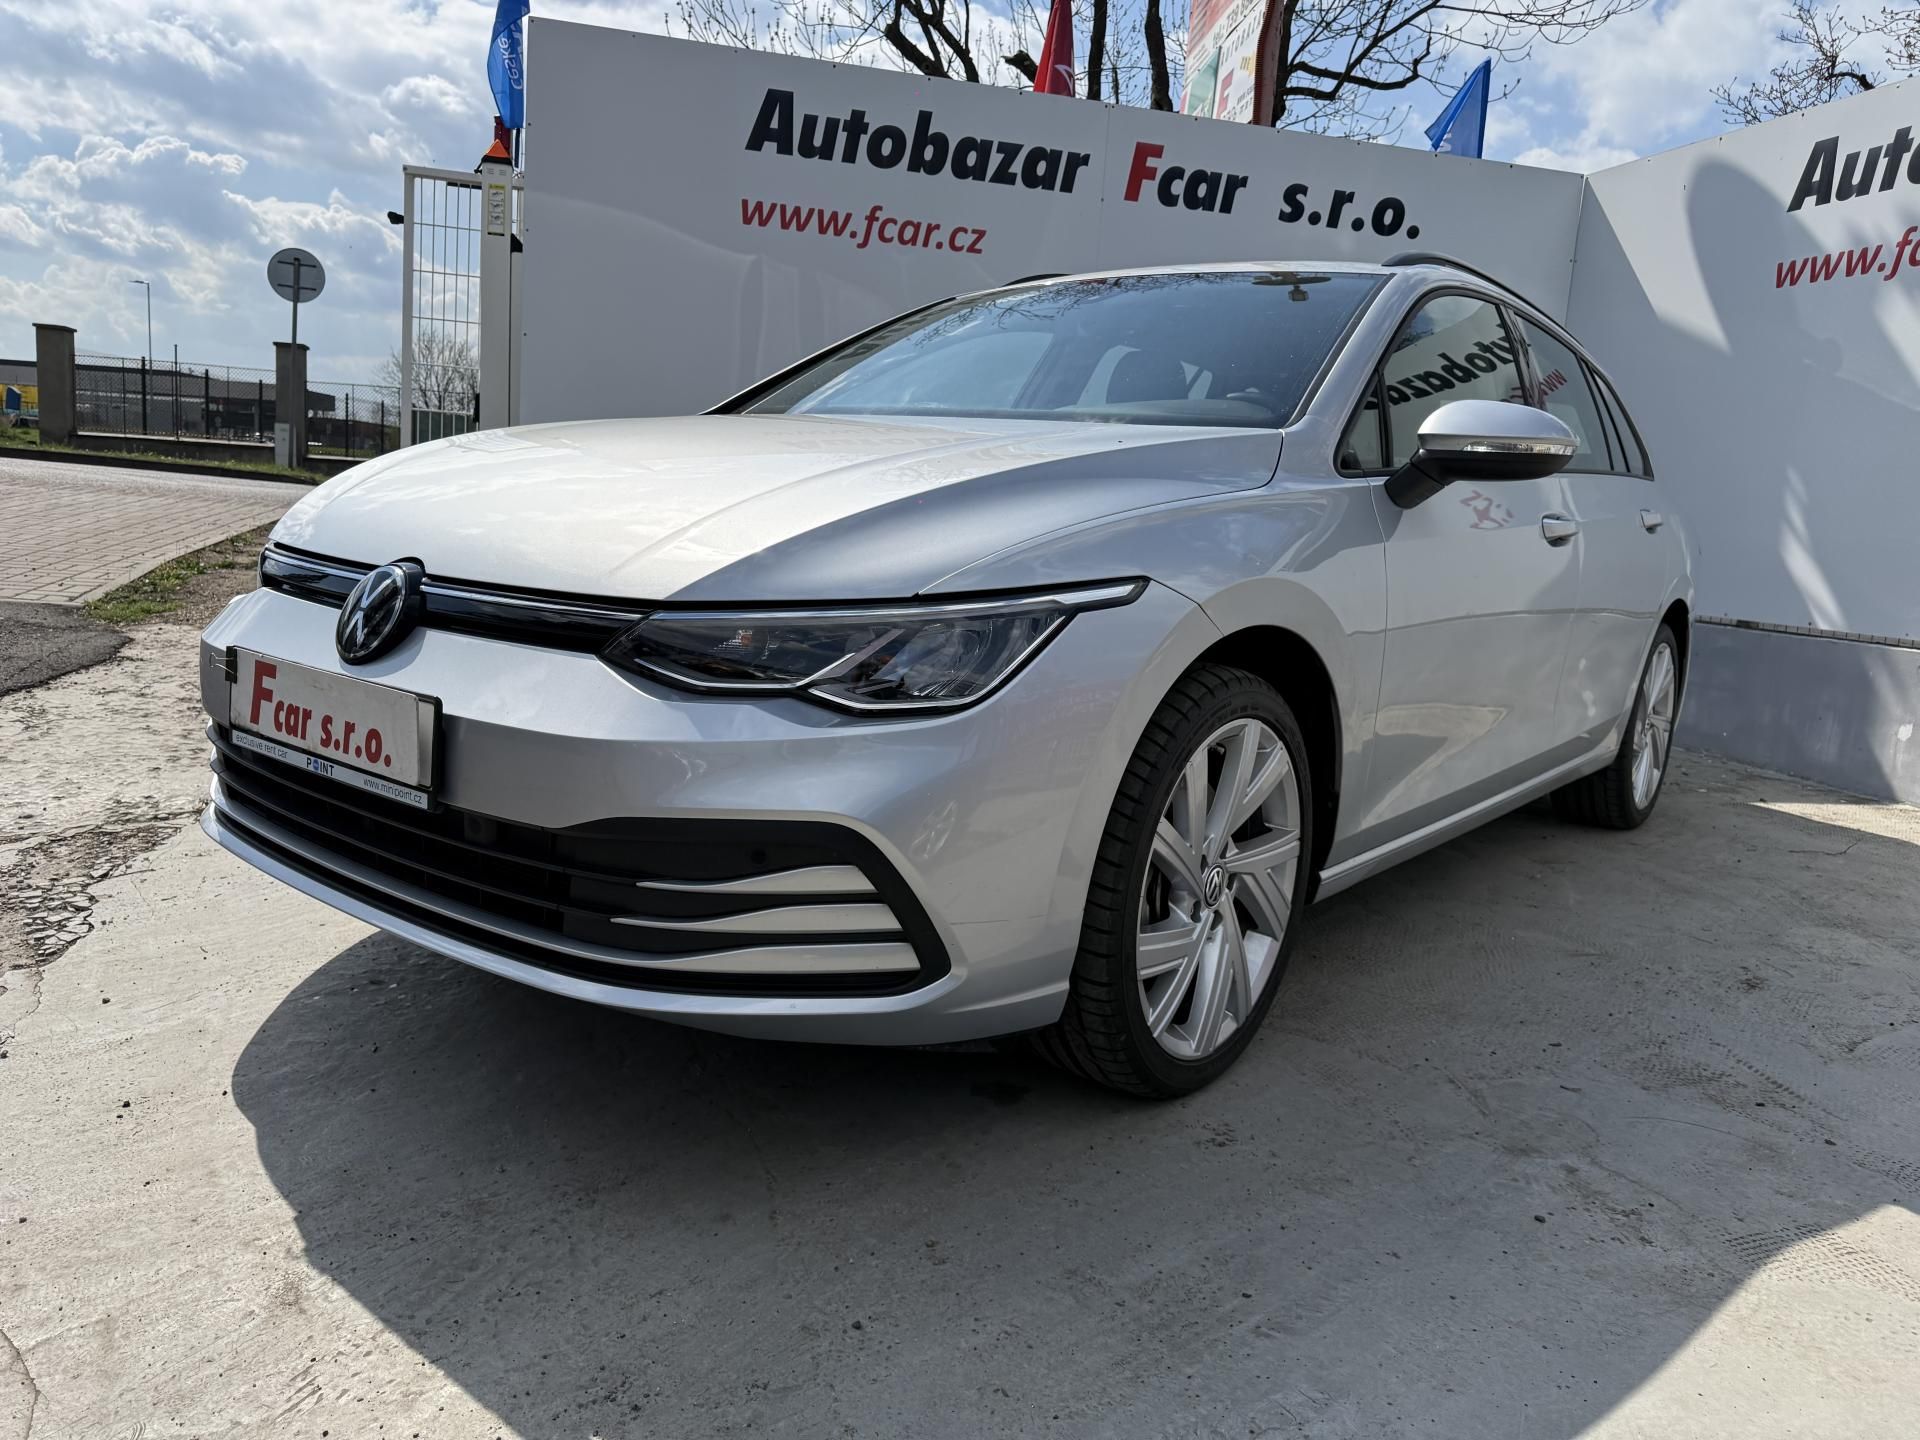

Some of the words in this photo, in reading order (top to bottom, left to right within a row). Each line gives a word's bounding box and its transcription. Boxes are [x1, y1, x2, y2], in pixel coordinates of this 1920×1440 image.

[745, 88, 1091, 194] Autobazar
[1123, 141, 1249, 214] Fcar
[1278, 183, 1420, 240] s.r.o.
[741, 199, 987, 255] www.fcar.cz
[235, 734, 263, 751] exclusive
[264, 744, 277, 756] rent
[278, 748, 288, 759] car
[320, 714, 392, 768] s.r.o.
